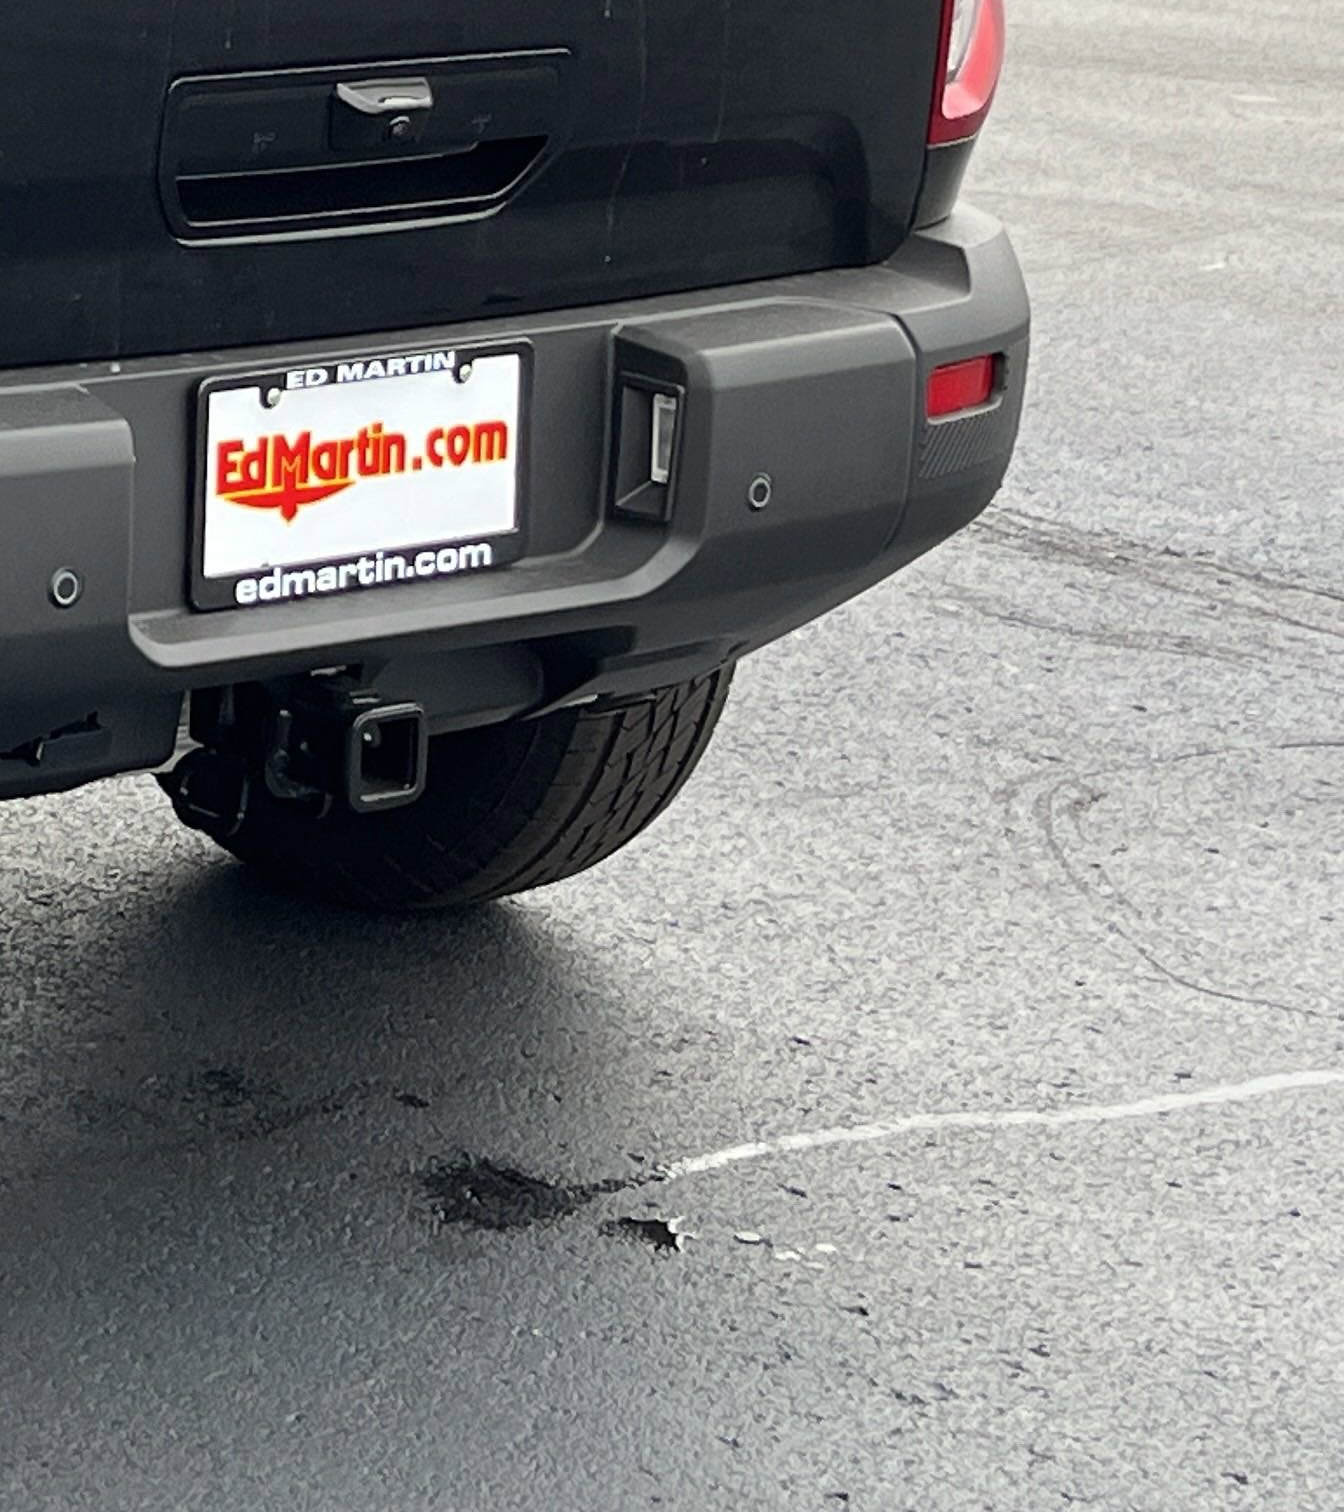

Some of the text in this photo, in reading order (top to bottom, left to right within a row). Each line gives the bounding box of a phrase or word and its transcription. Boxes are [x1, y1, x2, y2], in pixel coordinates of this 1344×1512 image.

[285, 351, 455, 390] ED MARTIN
[235, 542, 492, 605] edmartin.com
